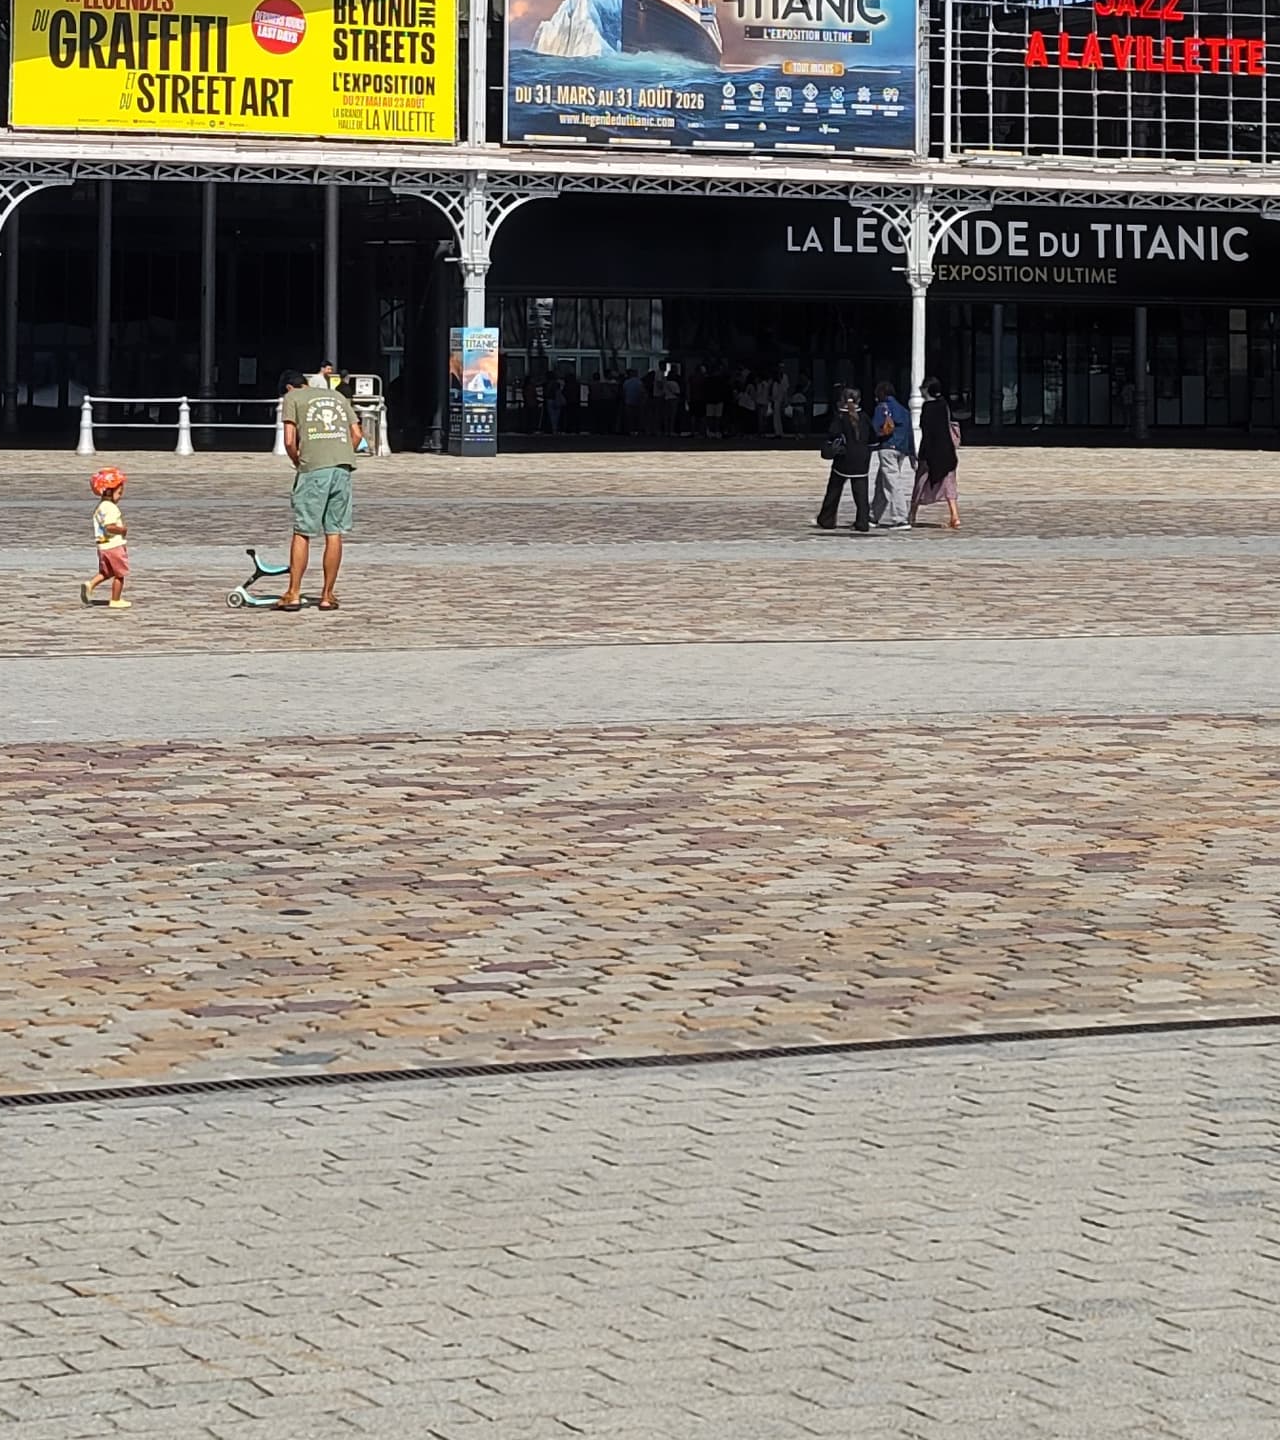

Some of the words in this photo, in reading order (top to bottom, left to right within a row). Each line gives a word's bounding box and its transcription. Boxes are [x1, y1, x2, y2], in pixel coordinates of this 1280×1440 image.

[32, 9, 50, 31] DU
[49, 9, 228, 73] GRAFFITI
[257, 25, 277, 40] LAST
[277, 29, 298, 44] DAYS
[333, 28, 436, 64] STREETS
[763, 27, 820, 41] L'EXPOSITION
[823, 30, 853, 42] ULTIME
[1025, 31, 1048, 68] A
[1058, 32, 1104, 70] LA
[1110, 34, 1266, 76] VILLETTE
[126, 72, 136, 90] ET
[333, 72, 435, 96] L'EXPOSITION
[120, 92, 133, 110] DU
[137, 73, 236, 116] STREET
[240, 77, 294, 118] ART
[343, 95, 354, 106] DU
[355, 96, 365, 106] 27
[365, 96, 381, 107] MAI
[382, 97, 393, 107] AU
[394, 97, 405, 108] 23
[515, 87, 532, 103] DU
[535, 84, 552, 104] 31
[557, 85, 596, 106] MARS
[598, 89, 614, 106] AU
[617, 88, 633, 108] 31
[638, 84, 673, 109] AOÛT
[676, 92, 705, 110] 2026
[340, 108, 363, 119] GRANDE
[365, 109, 380, 131] LA
[383, 110, 435, 133] VILLETTE
[786, 226, 823, 253] LA
[833, 209, 1029, 257] LÉGNDE
[1038, 232, 1080, 259] DU
[1090, 223, 1250, 262] TITANIC
[934, 263, 1048, 283] 'EXPOSITION
[1053, 267, 1118, 285] ULTIME
